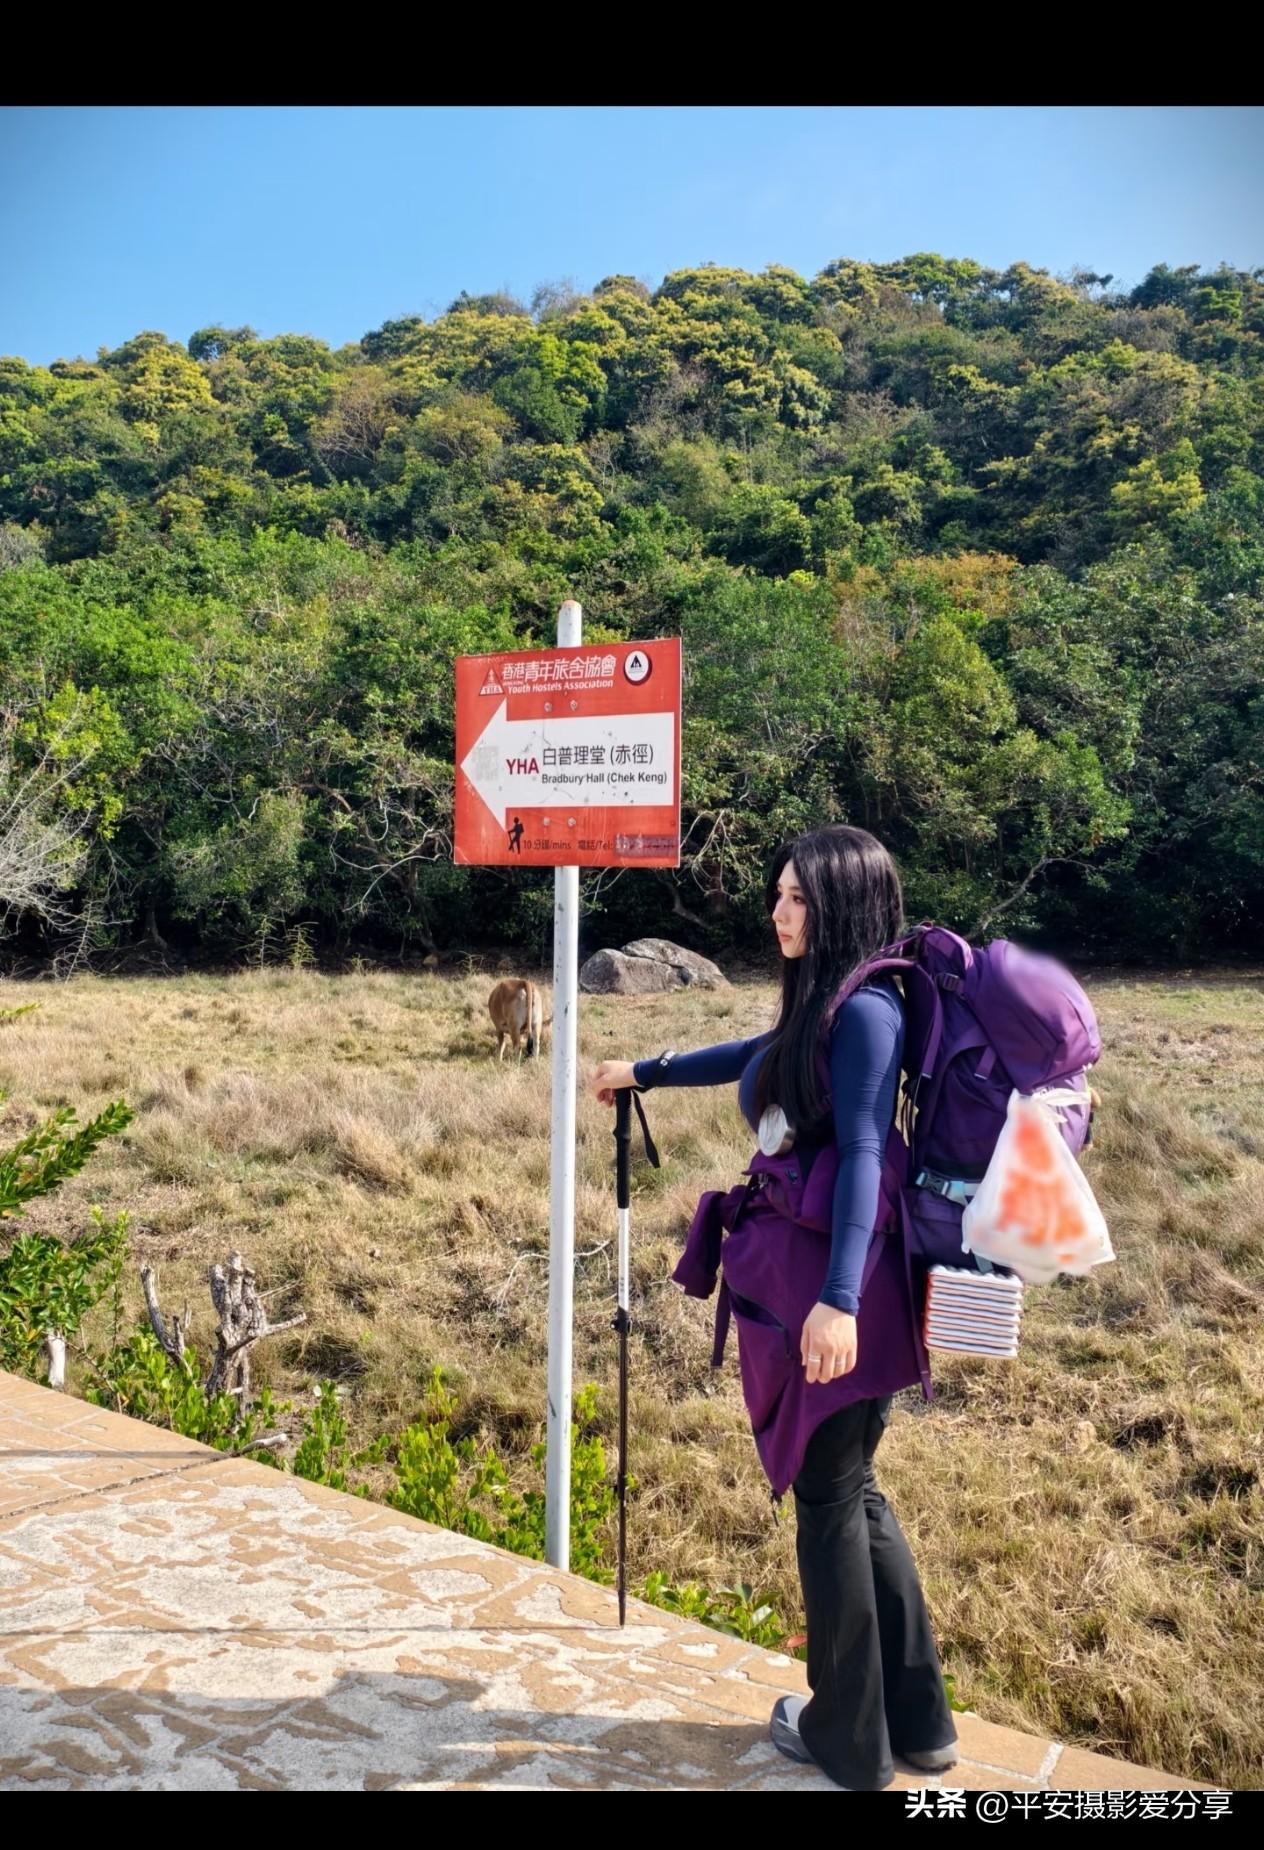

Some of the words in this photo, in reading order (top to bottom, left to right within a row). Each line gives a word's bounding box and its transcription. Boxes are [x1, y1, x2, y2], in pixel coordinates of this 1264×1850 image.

[502, 654, 617, 682] 香港青年旅舍協會
[507, 683, 531, 695] Youth
[532, 682, 561, 693] Hostels
[564, 679, 613, 691] Association
[542, 746, 605, 766] 白普理堂
[610, 744, 654, 765] (赤徑)
[506, 757, 539, 775] YHA
[541, 773, 584, 785] Bradbury
[586, 772, 605, 784] Hall
[607, 772, 636, 785] (Chek
[638, 772, 668, 785] Keng)
